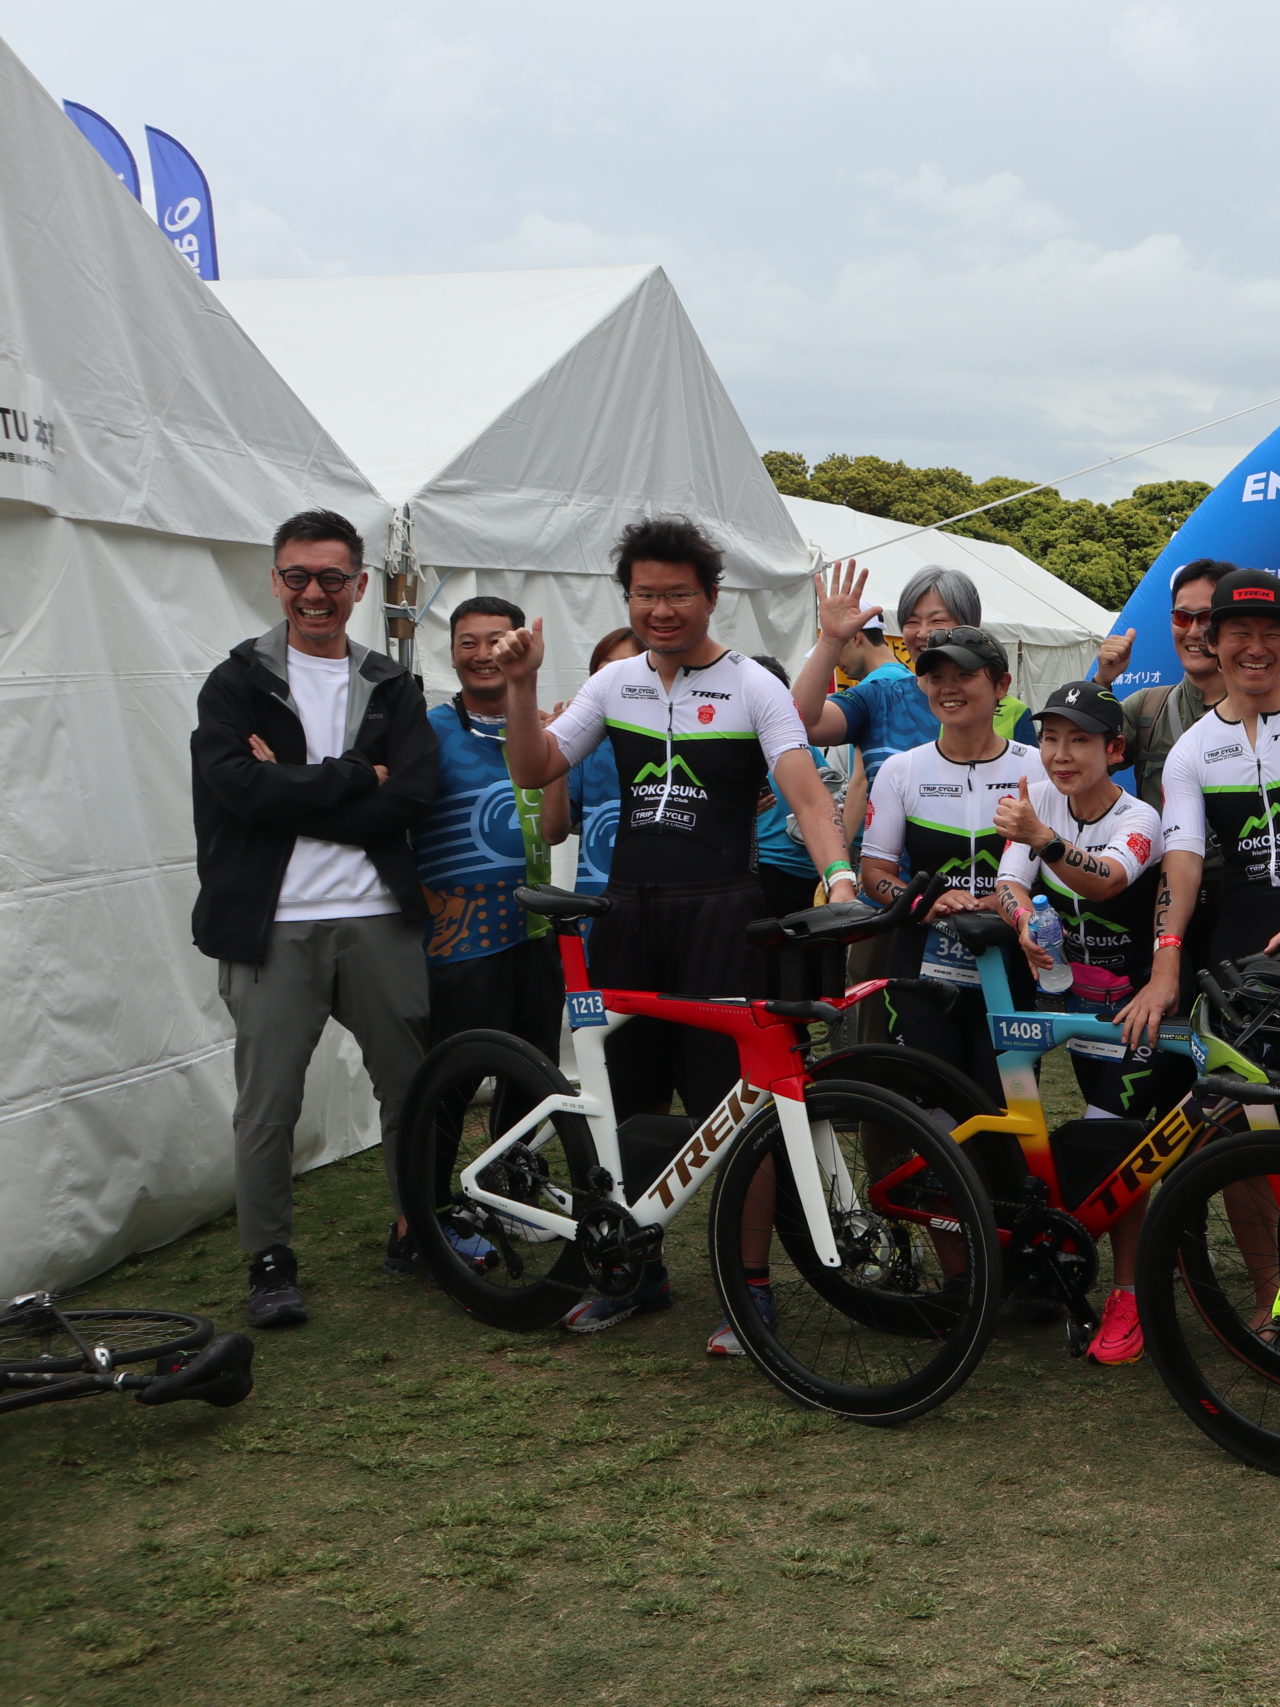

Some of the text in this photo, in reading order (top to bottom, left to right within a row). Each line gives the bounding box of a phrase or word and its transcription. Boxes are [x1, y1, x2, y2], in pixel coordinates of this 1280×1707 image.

[690, 690, 733, 701] TREK
[1206, 751, 1220, 759] TRIP
[1220, 745, 1240, 755] CYCLE
[630, 783, 709, 801] YOKOSUKA
[985, 782, 1020, 790] TRE
[635, 810, 654, 820] TRIP
[571, 995, 604, 1015] 1213
[999, 1021, 1043, 1040] 1408
[648, 1070, 761, 1210] TREK
